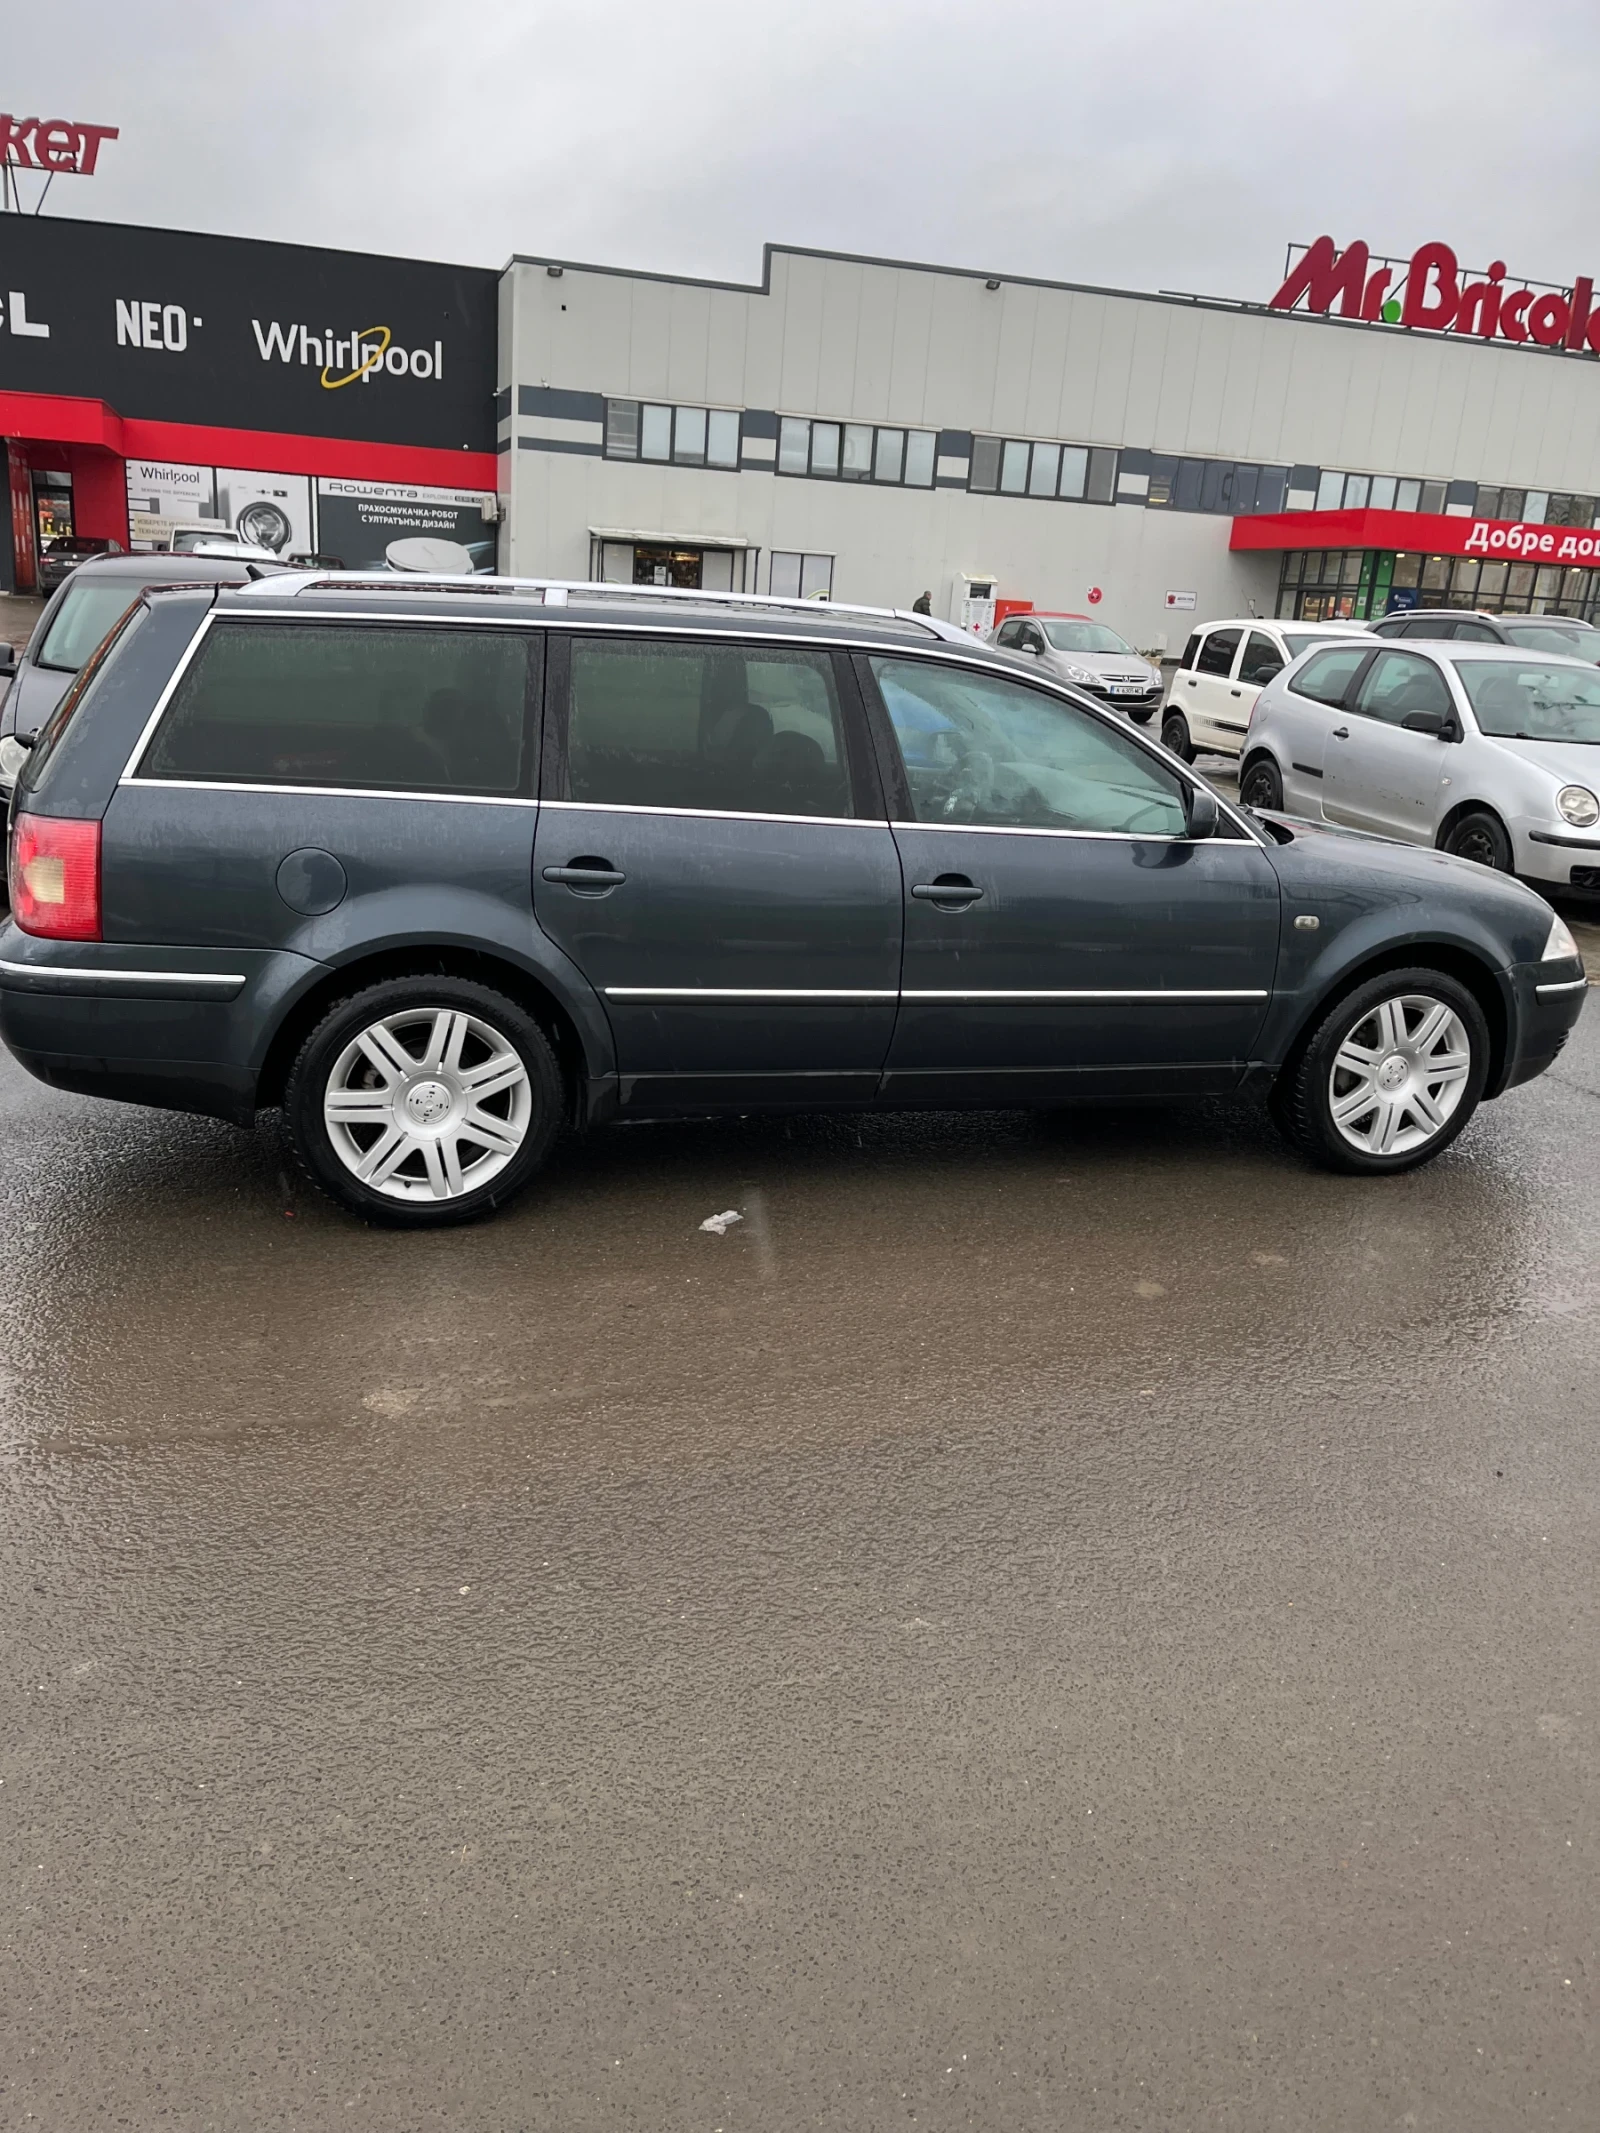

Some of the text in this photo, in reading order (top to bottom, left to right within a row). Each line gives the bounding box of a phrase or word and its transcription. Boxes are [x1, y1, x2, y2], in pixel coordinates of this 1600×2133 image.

[251, 319, 443, 384] Whirlpool
[140, 466, 200, 484] Whirlpool
[329, 482, 418, 498] Rowenta
[358, 503, 459, 519] ПРАХОСМУКАЧКА-РОБОТ
[368, 514, 421, 527] УЛТРАТЪНЪК
[421, 519, 456, 529] ДИЗАЙН
[1464, 522, 1555, 556] Добре
